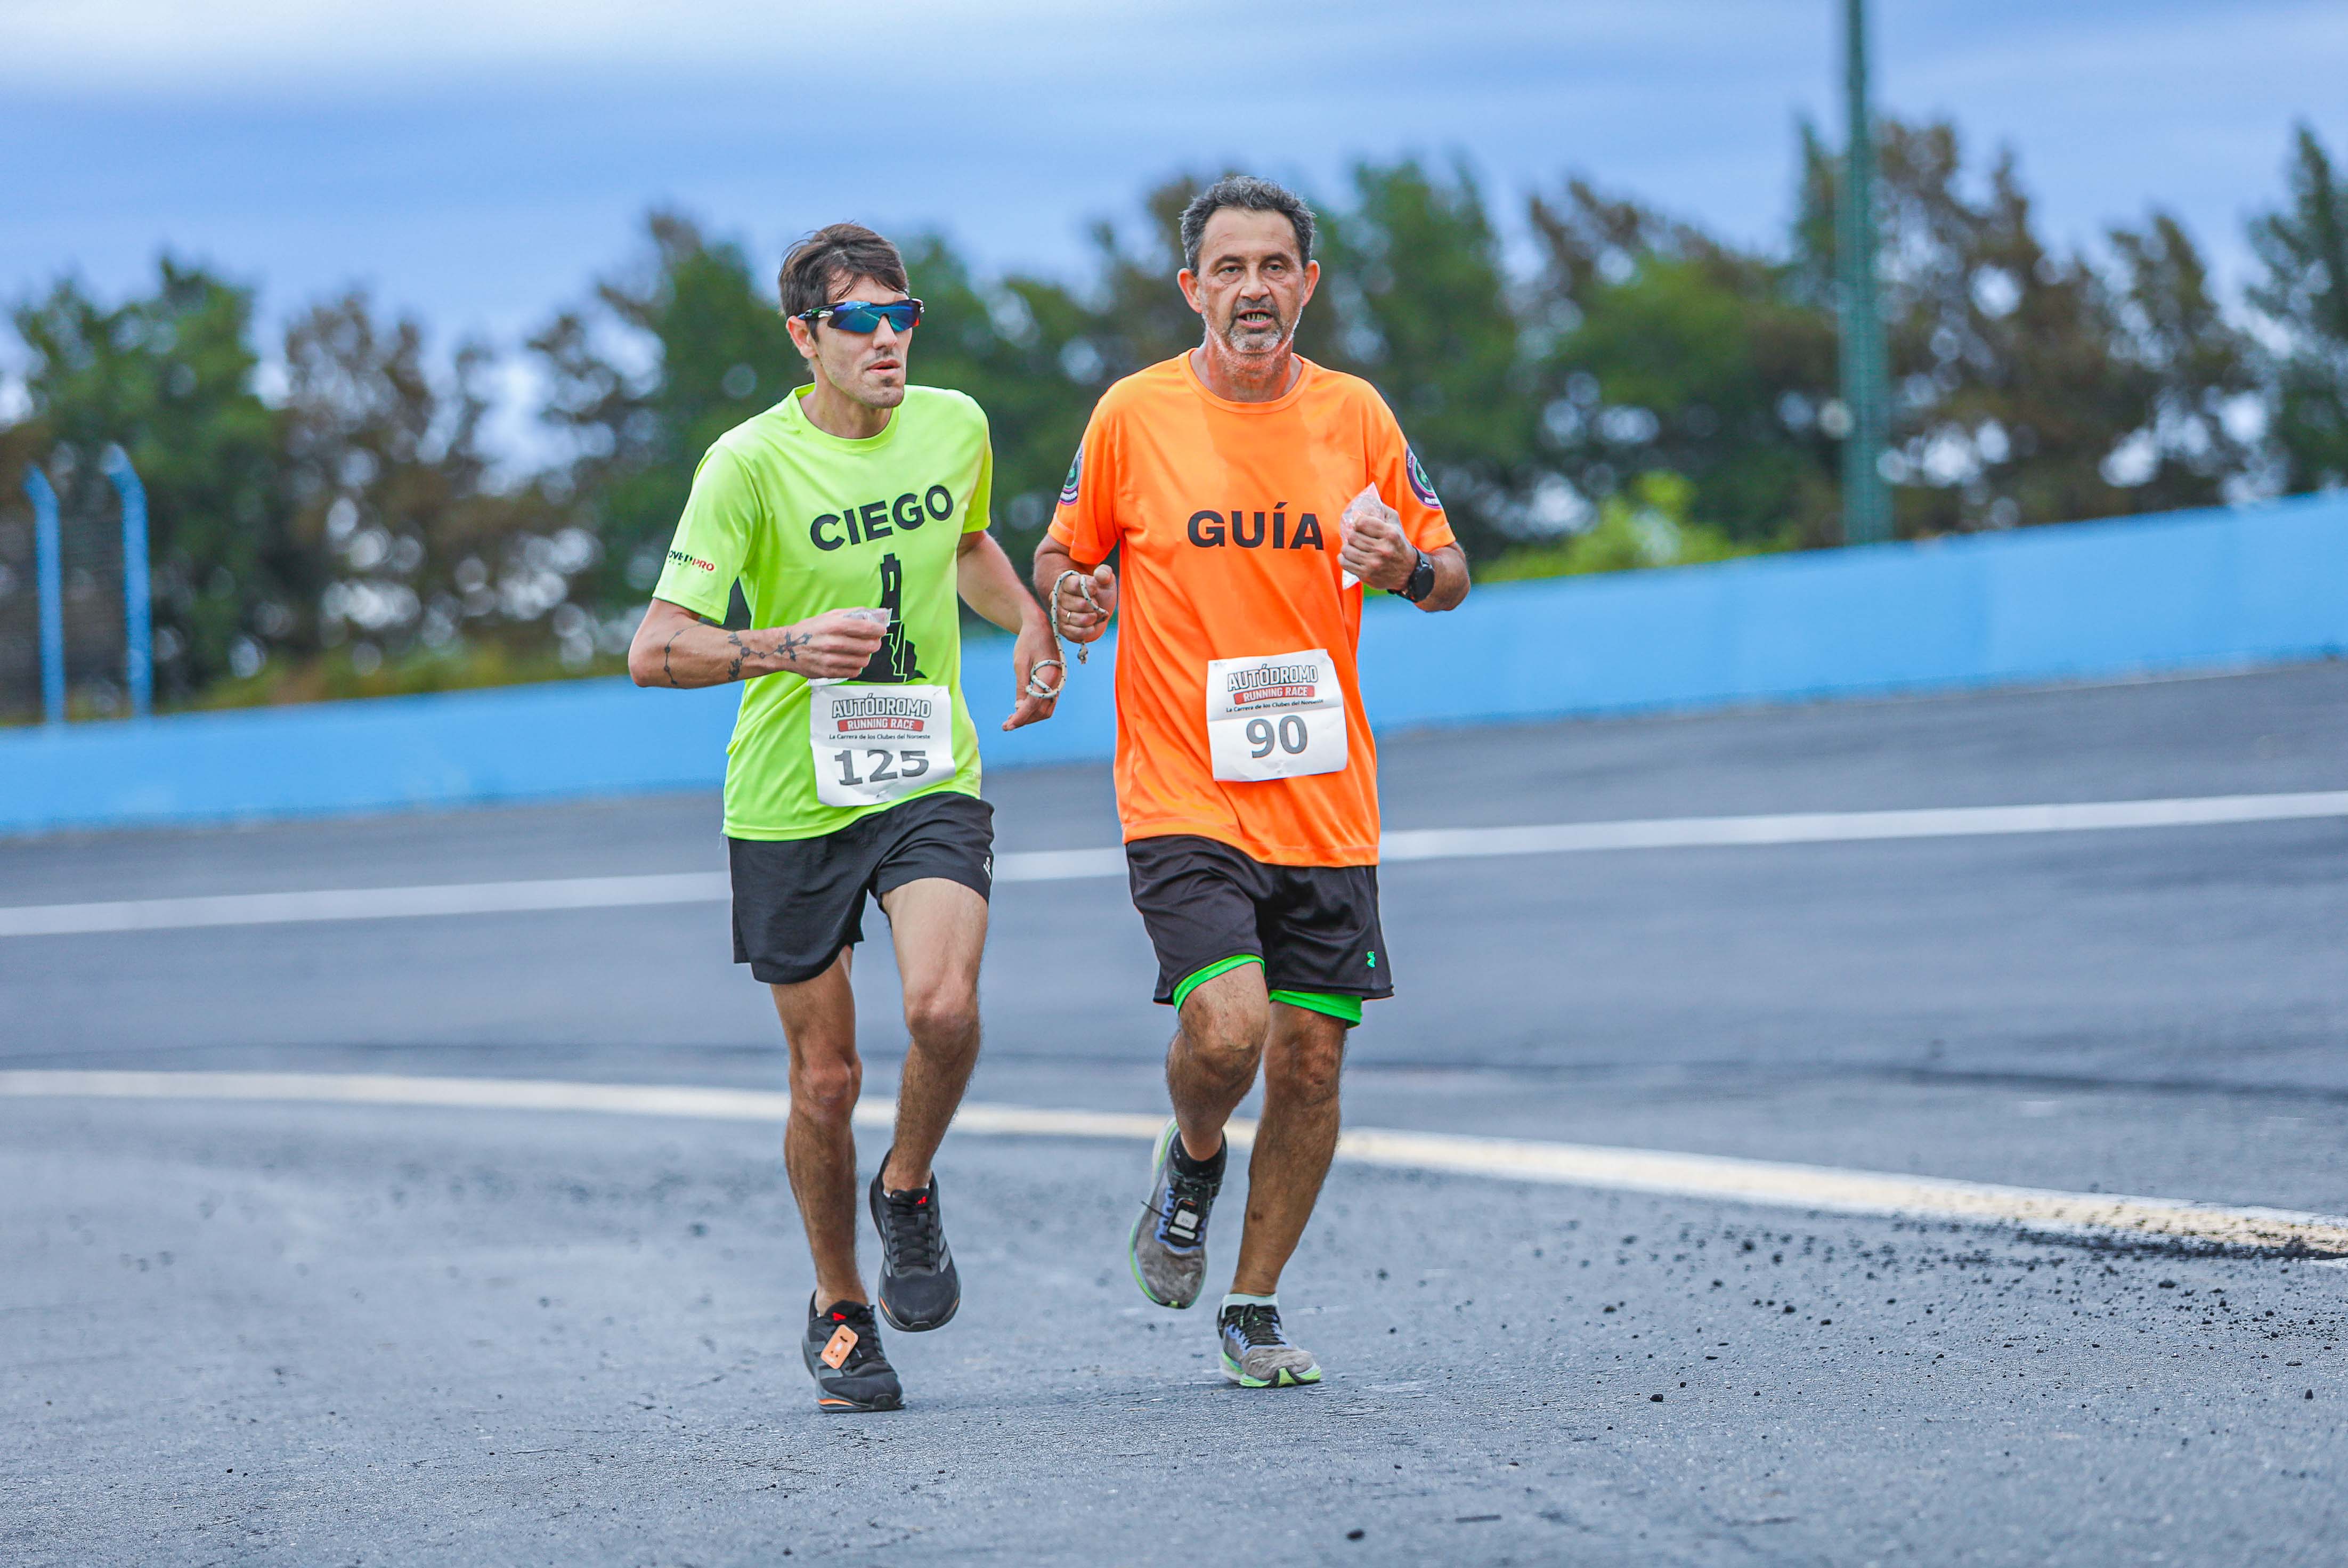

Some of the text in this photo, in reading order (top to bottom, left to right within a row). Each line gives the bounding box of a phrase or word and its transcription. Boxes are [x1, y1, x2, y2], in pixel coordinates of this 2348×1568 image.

[810, 485, 953, 551] CIEGO
[1188, 502, 1325, 551] GUÍA
[1228, 663, 1319, 692] AUTÓDROMO
[1243, 686, 1308, 702] RUNNING RACE
[832, 693, 931, 718] AUTÓDROMO
[847, 718, 915, 730] RUNNING RACE
[1246, 715, 1308, 759] 90
[834, 749, 929, 786] 125
